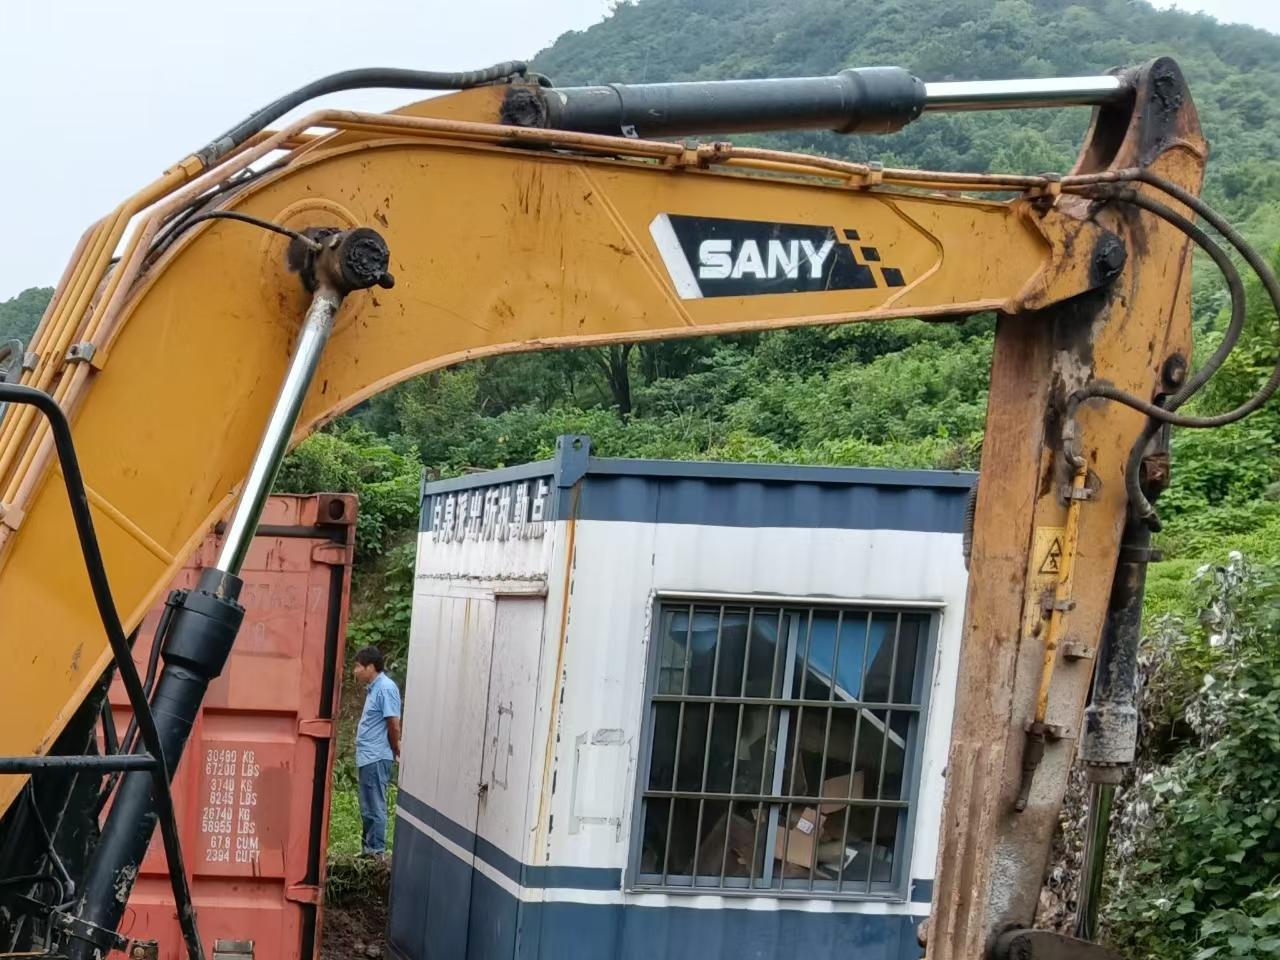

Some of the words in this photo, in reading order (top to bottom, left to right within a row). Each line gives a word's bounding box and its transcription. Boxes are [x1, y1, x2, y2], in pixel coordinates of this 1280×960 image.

[699, 239, 836, 279] SANY
[207, 749, 237, 763] 30480
[242, 750, 255, 764] KG
[205, 763, 236, 776] 67200
[241, 764, 260, 777] LBS
[210, 778, 235, 791] 3740
[240, 779, 253, 792] KG
[209, 792, 234, 805] 8245
[239, 793, 258, 805] LBS
[203, 807, 233, 820] 26740
[238, 808, 250, 821] KG
[237, 821, 256, 834] LBS
[206, 849, 230, 862] 2394
